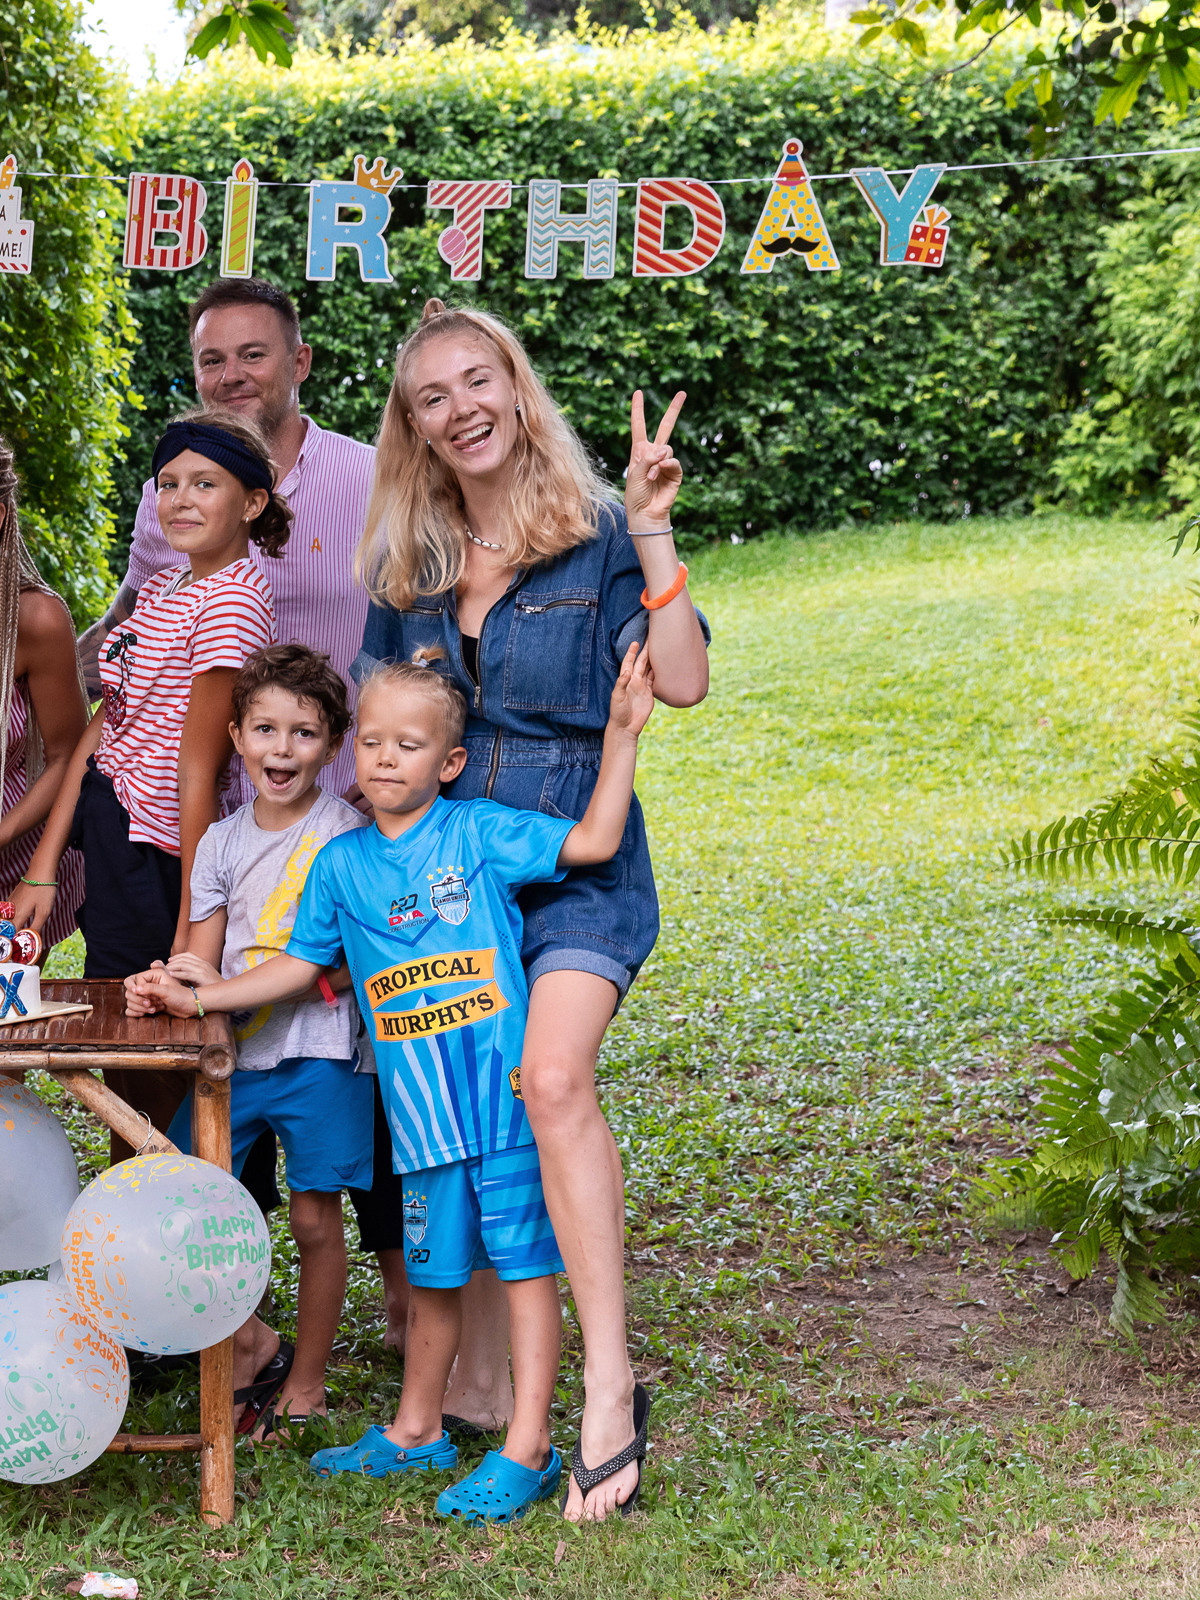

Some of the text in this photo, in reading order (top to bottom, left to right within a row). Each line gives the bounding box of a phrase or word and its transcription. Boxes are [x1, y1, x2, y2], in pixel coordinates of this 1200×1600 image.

[122, 138, 952, 283] BIRTHDAY
[387, 917, 430, 934] CONSTRUCTION
[370, 956, 481, 1000] TROPICAL
[380, 991, 495, 1036] MURPHY'S
[202, 1215, 256, 1239] HAPPY
[81, 1251, 103, 1312] HAPPY
[82, 1332, 120, 1374] HAPPY
